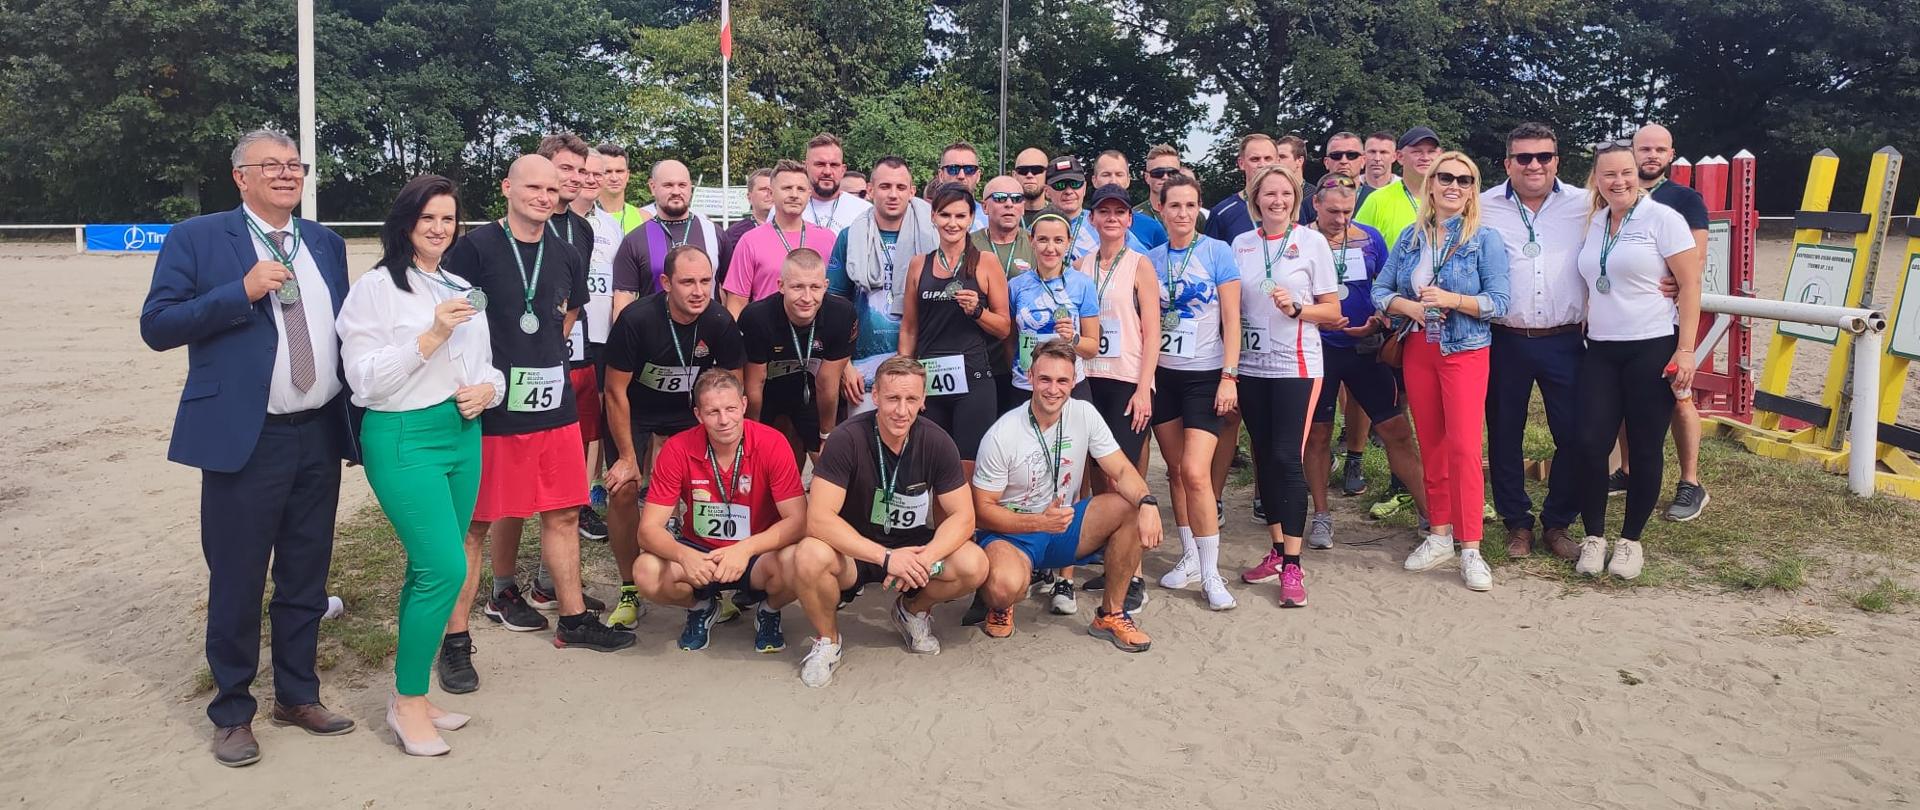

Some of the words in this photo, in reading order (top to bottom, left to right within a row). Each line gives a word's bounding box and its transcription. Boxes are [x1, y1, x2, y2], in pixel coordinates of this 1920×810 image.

[588, 276, 607, 293] 33
[1160, 333, 1183, 355] 21
[1243, 331, 1262, 351] 12
[655, 377, 682, 391] 18
[931, 373, 956, 393] 40
[523, 386, 554, 409] 45
[707, 518, 737, 538] 20
[889, 509, 917, 528] 49
